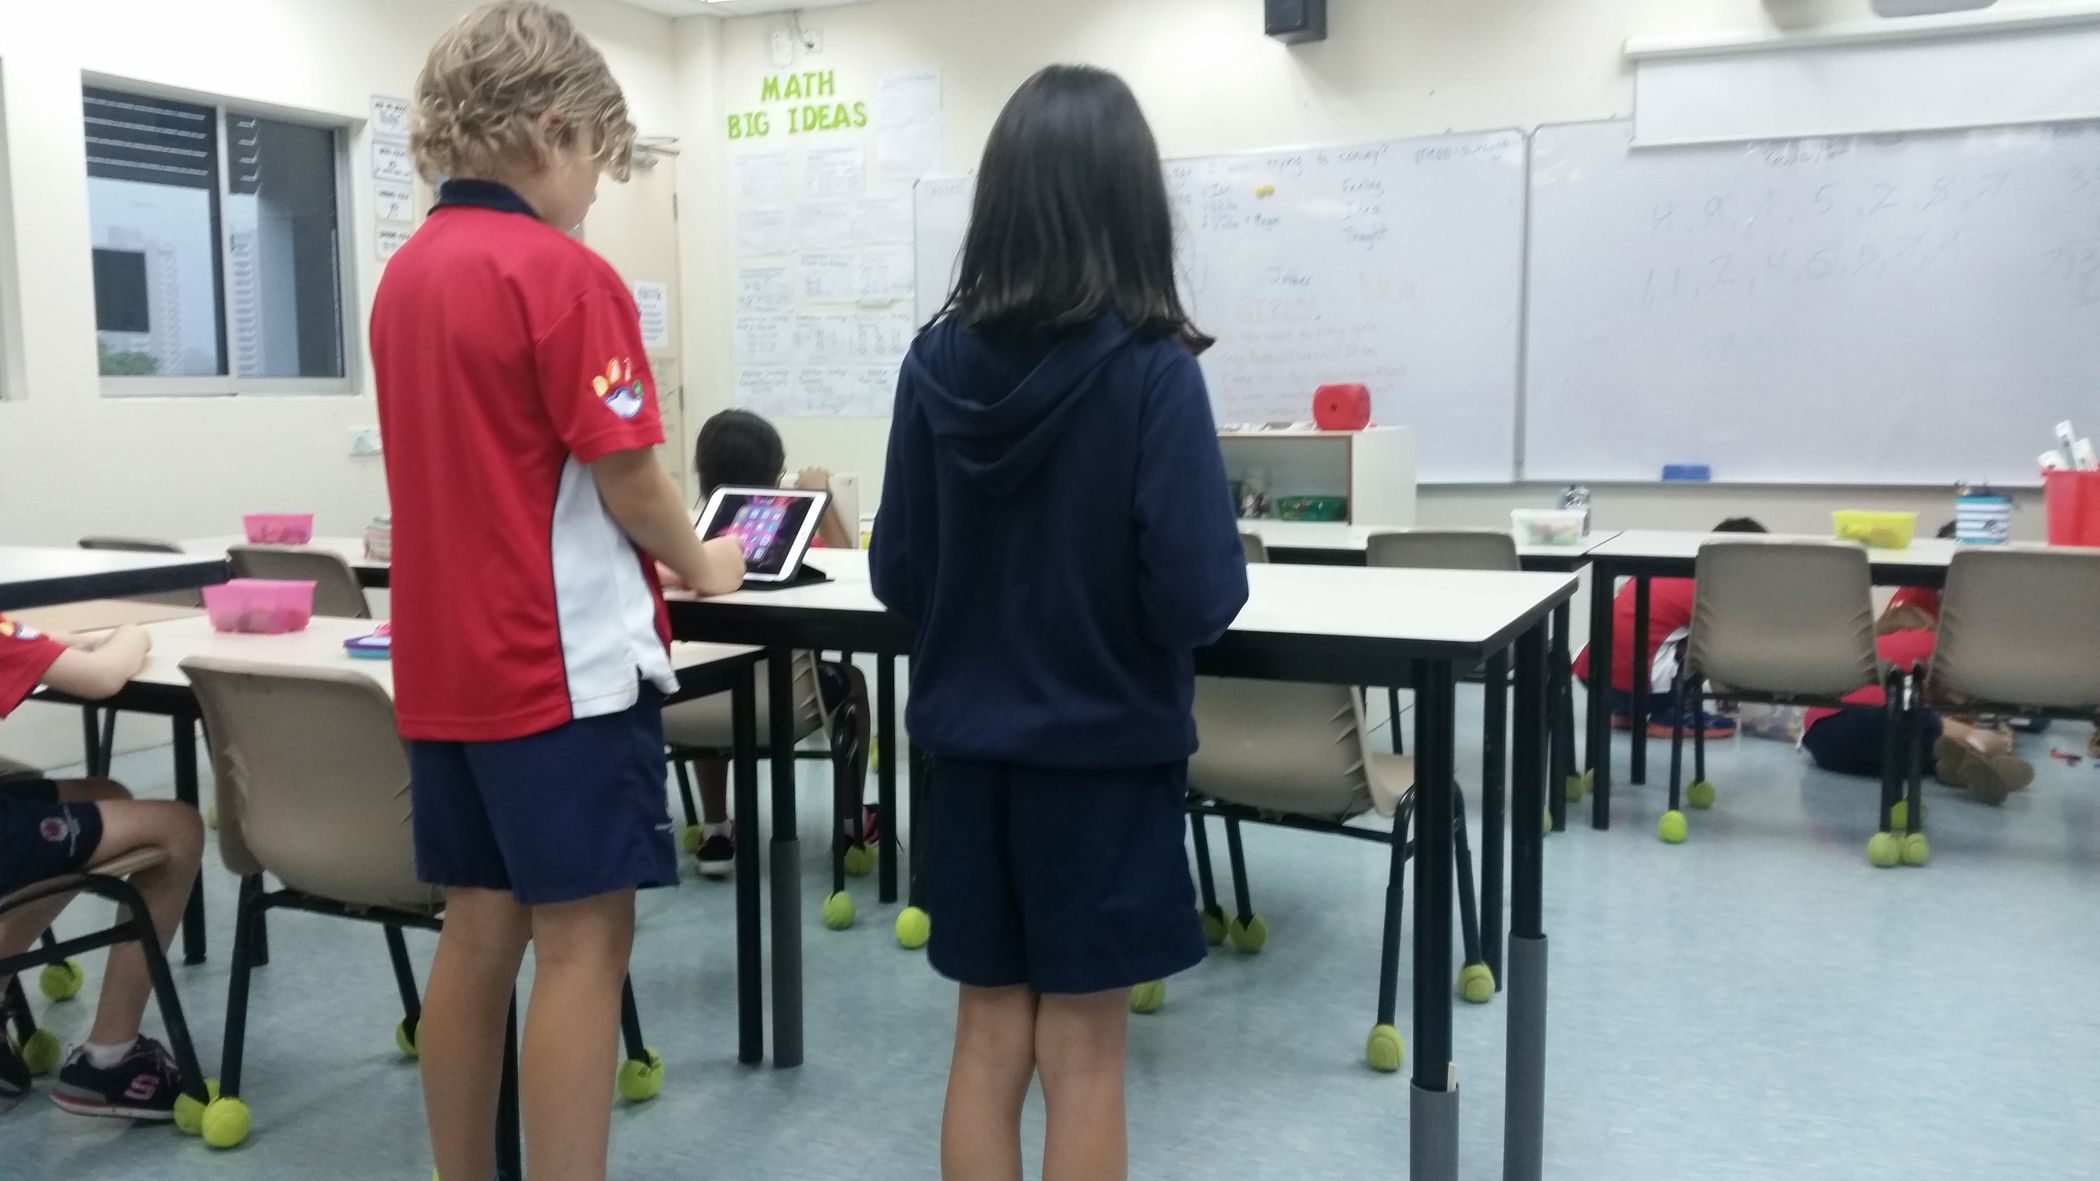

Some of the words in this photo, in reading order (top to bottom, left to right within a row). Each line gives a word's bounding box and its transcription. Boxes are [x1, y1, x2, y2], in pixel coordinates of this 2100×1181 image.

[760, 70, 835, 103] MATH
[727, 109, 770, 141] BIG
[787, 100, 869, 134] IDEAS
